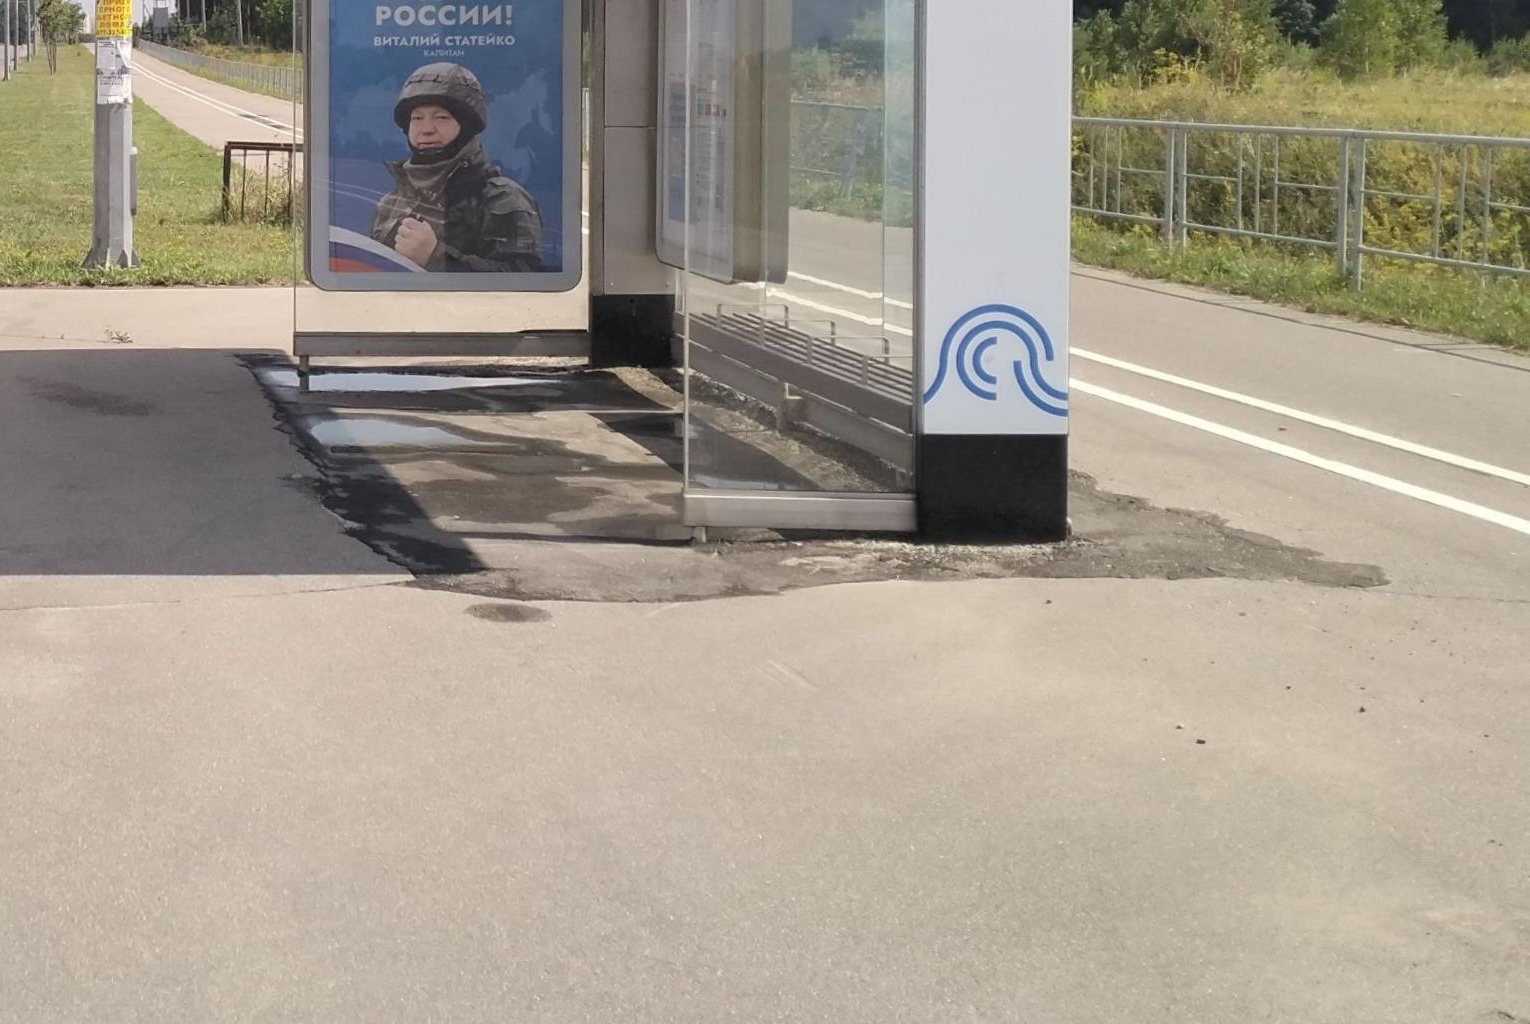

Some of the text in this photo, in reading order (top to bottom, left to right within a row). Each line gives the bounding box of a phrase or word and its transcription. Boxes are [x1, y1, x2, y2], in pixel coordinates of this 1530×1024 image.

[375, 5, 513, 26] РОССИИ!
[373, 33, 516, 47] ВИТАЛИЙ СТАТЕЙКО
